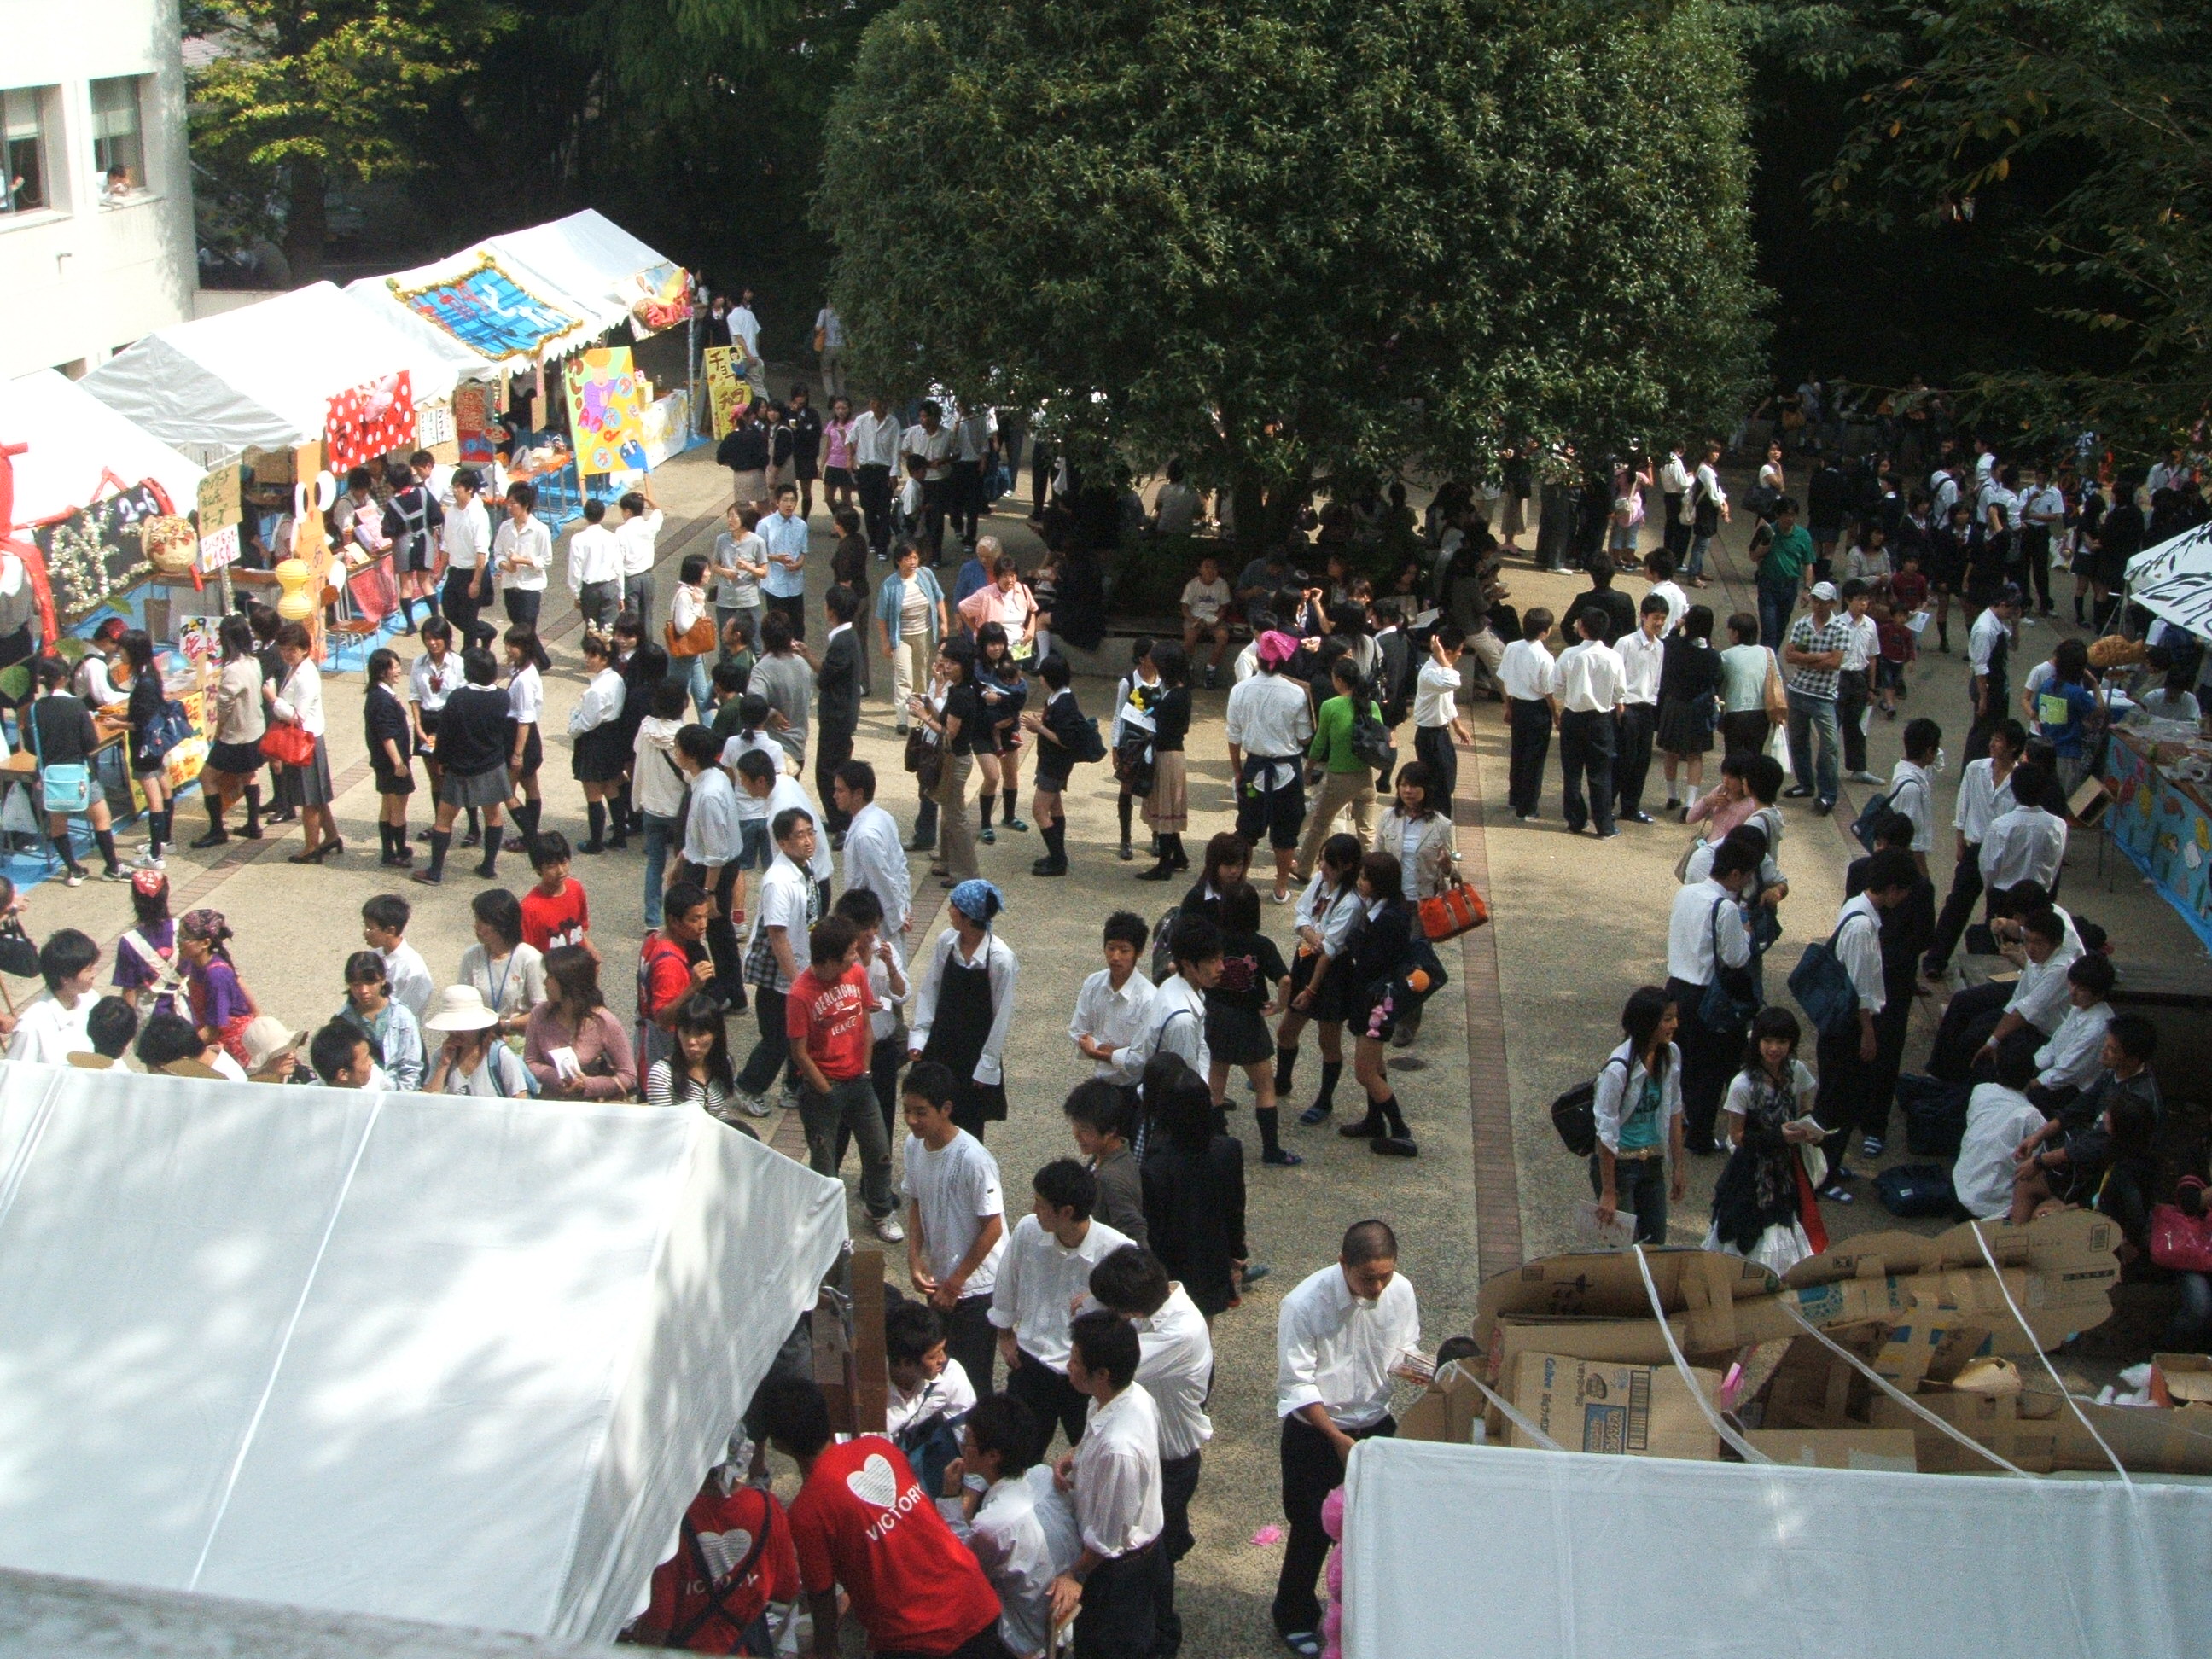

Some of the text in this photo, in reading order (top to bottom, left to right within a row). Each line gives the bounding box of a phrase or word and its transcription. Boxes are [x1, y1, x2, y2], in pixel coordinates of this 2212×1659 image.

[119, 487, 159, 522] 2-6
[1544, 1358, 1555, 1388] Calbee
[865, 1481, 925, 1541] VICTORY
